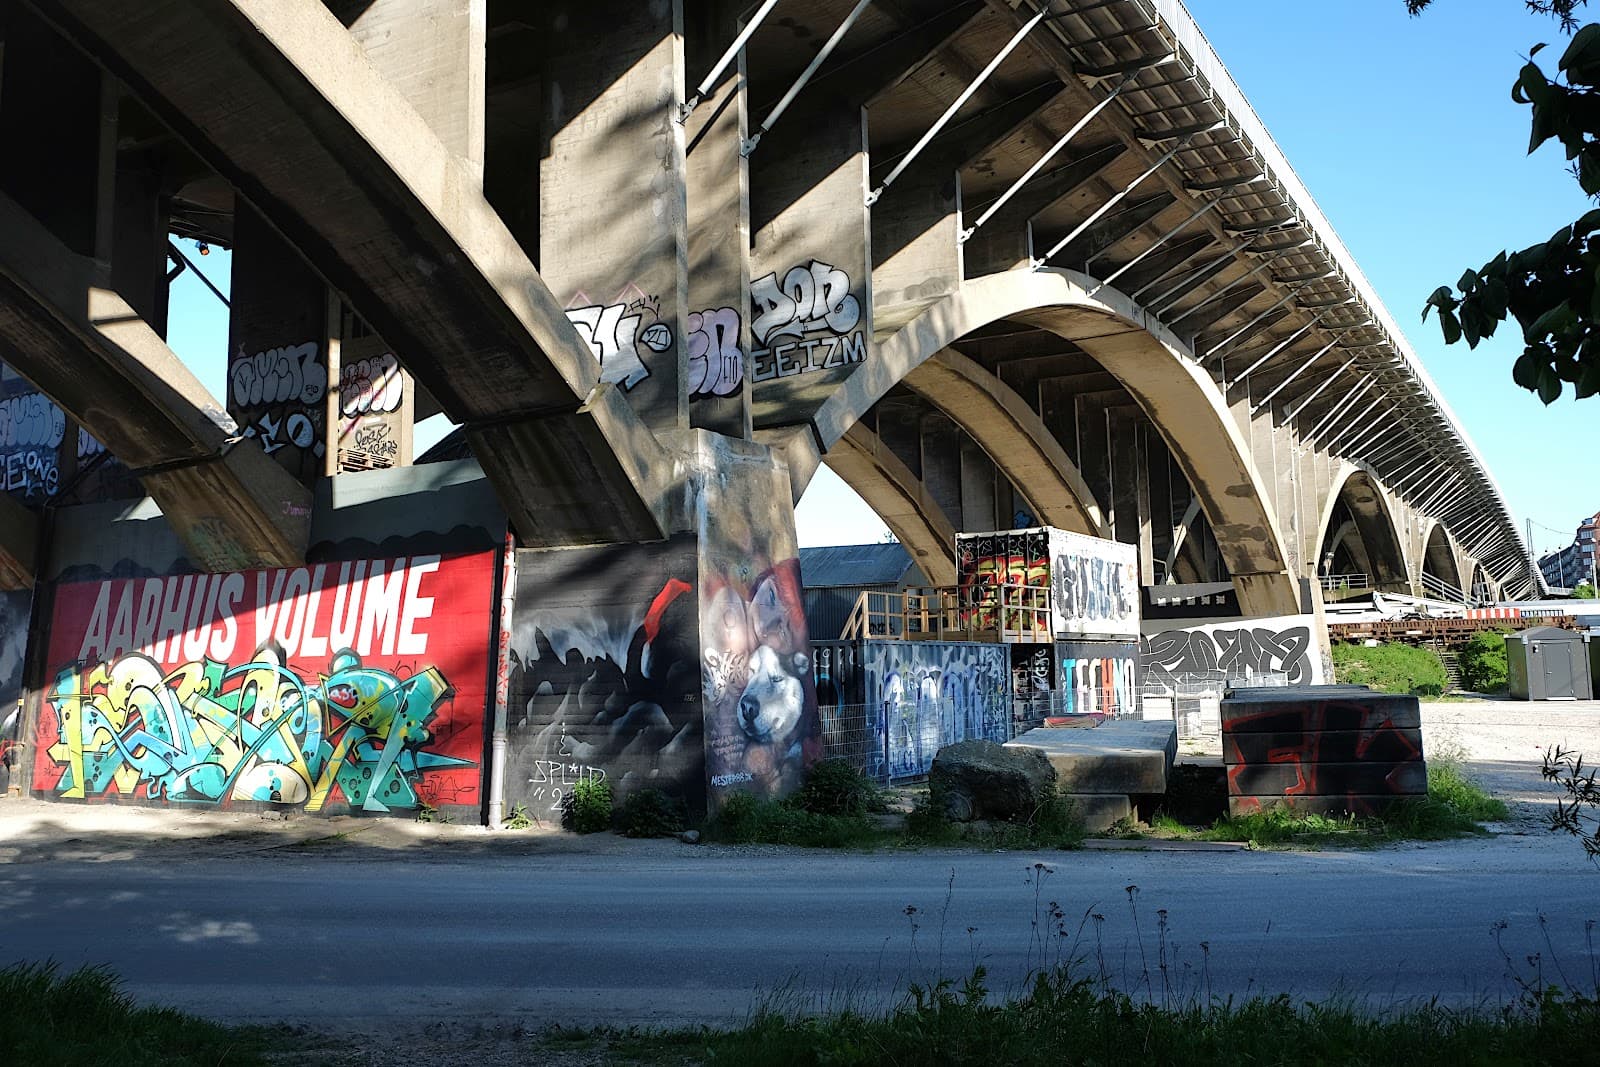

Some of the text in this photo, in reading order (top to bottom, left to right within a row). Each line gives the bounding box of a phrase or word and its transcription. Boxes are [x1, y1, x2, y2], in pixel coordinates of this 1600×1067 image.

[78, 572, 246, 666] AARHUS
[255, 554, 442, 659] VOLUME
[1063, 657, 1137, 714] TECHNO
